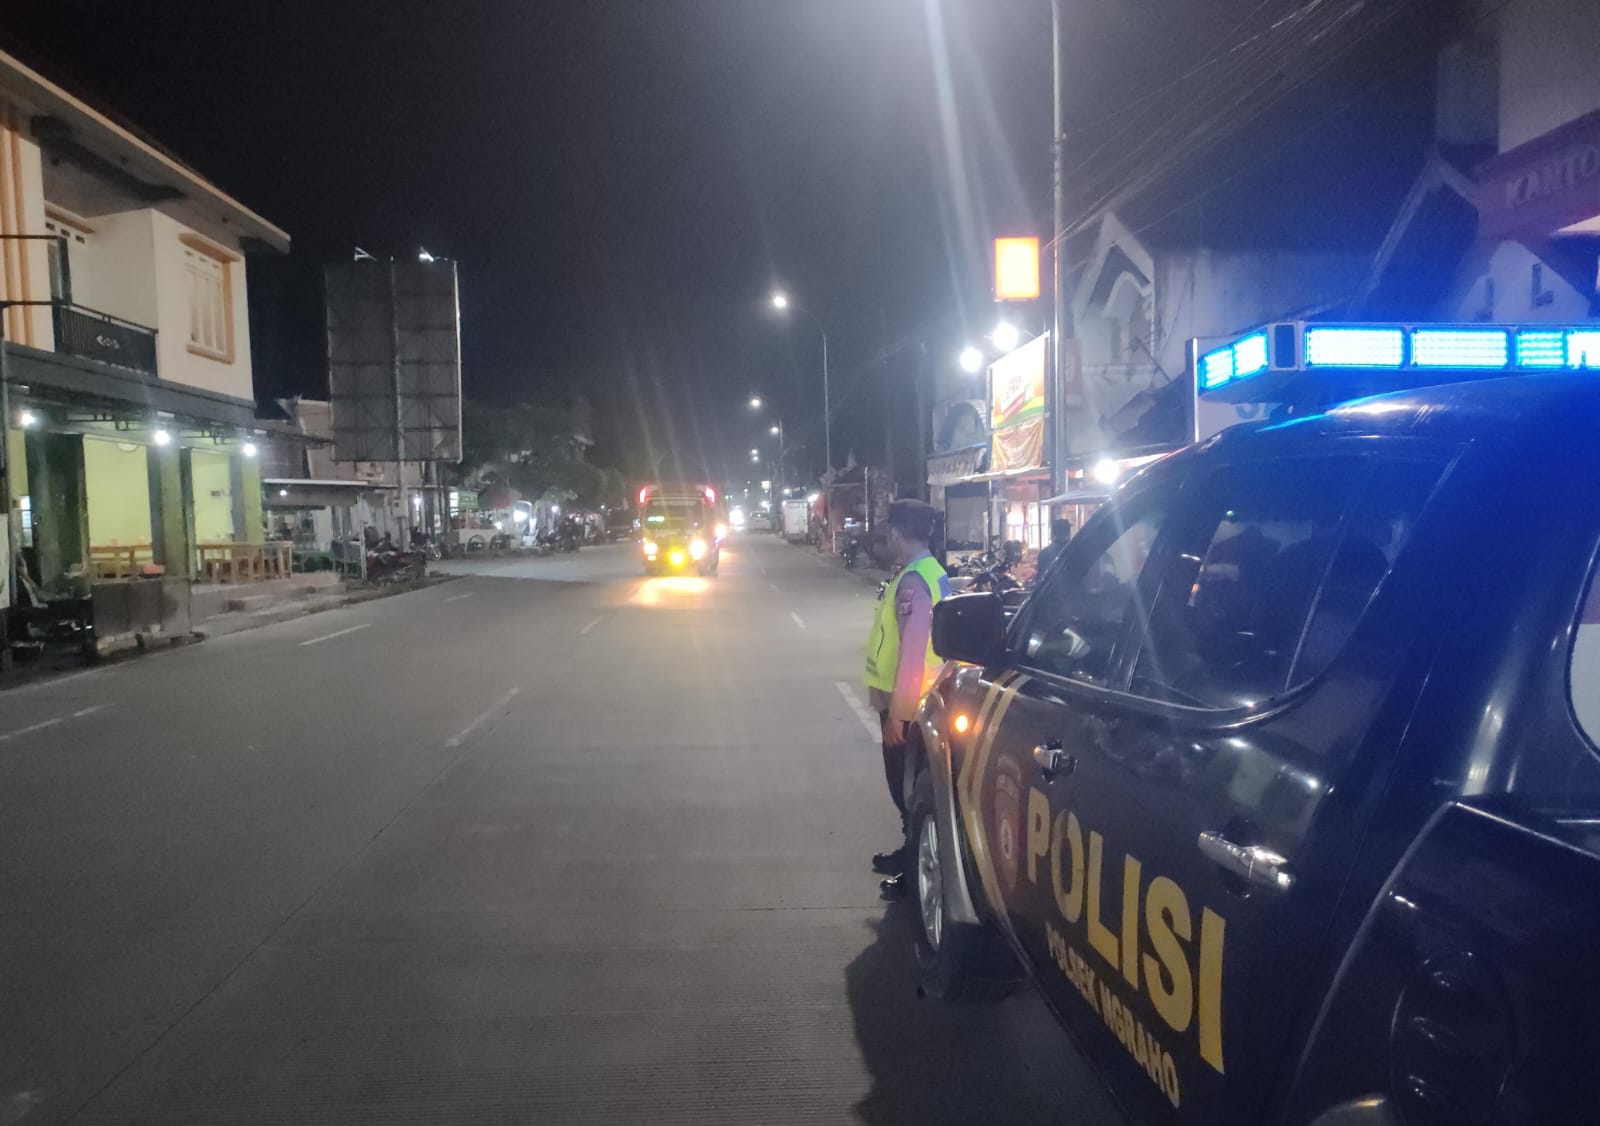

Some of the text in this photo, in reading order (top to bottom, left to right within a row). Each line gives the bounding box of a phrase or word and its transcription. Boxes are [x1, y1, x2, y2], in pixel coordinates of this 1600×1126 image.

[1027, 786, 1225, 1074] POLISI
[1045, 920, 1180, 1110] POLSEK NGRAHO
